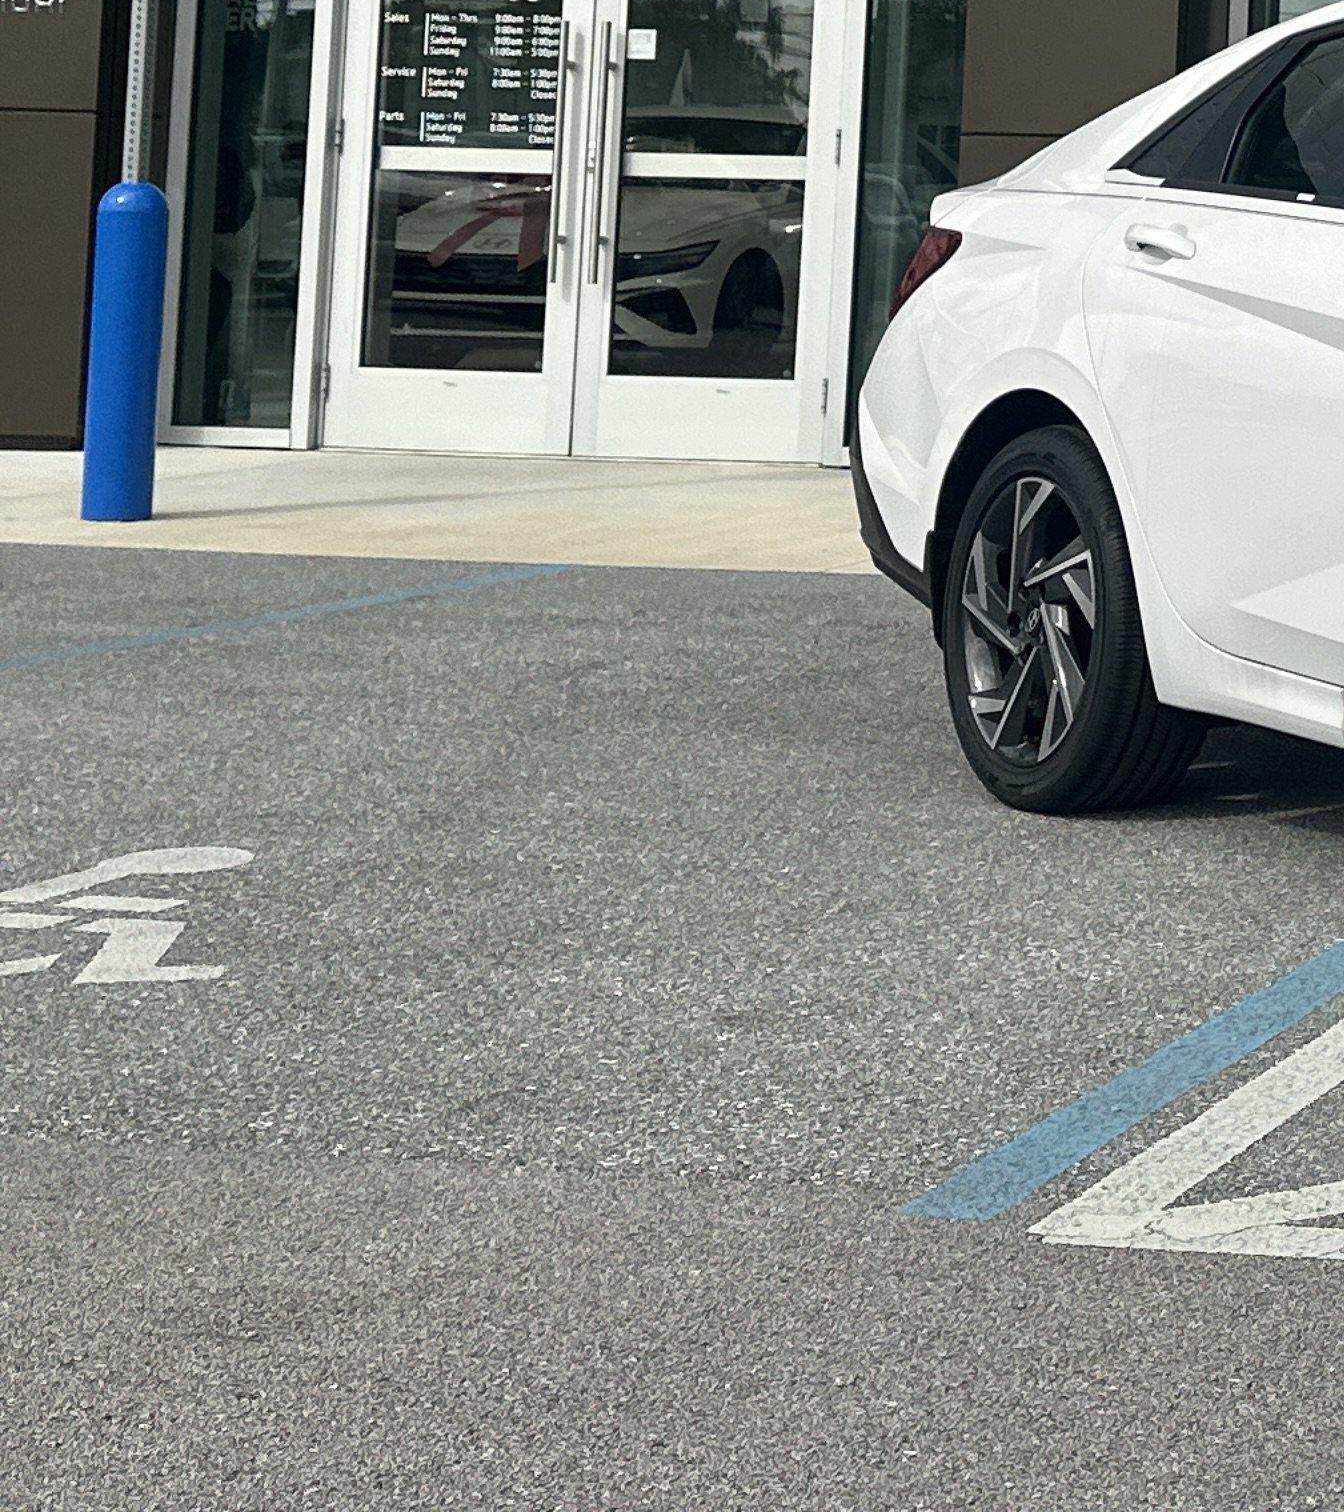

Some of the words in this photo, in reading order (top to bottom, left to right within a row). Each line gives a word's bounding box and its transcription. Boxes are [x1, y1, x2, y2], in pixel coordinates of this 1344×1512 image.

[384, 11, 409, 23] Sales
[431, 13, 450, 22] Mon
[430, 24, 457, 35] Friday
[430, 35, 467, 47] Saturday
[429, 47, 460, 58] Sunday
[381, 66, 417, 77] Service
[428, 67, 447, 76] Mon
[428, 78, 465, 89] Saturday
[427, 88, 458, 100] Sunday
[379, 110, 405, 121] Parts
[426, 111, 445, 121] Mon
[453, 111, 466, 121] Fri
[426, 122, 463, 133] Saturday
[425, 133, 456, 144] Sunday
